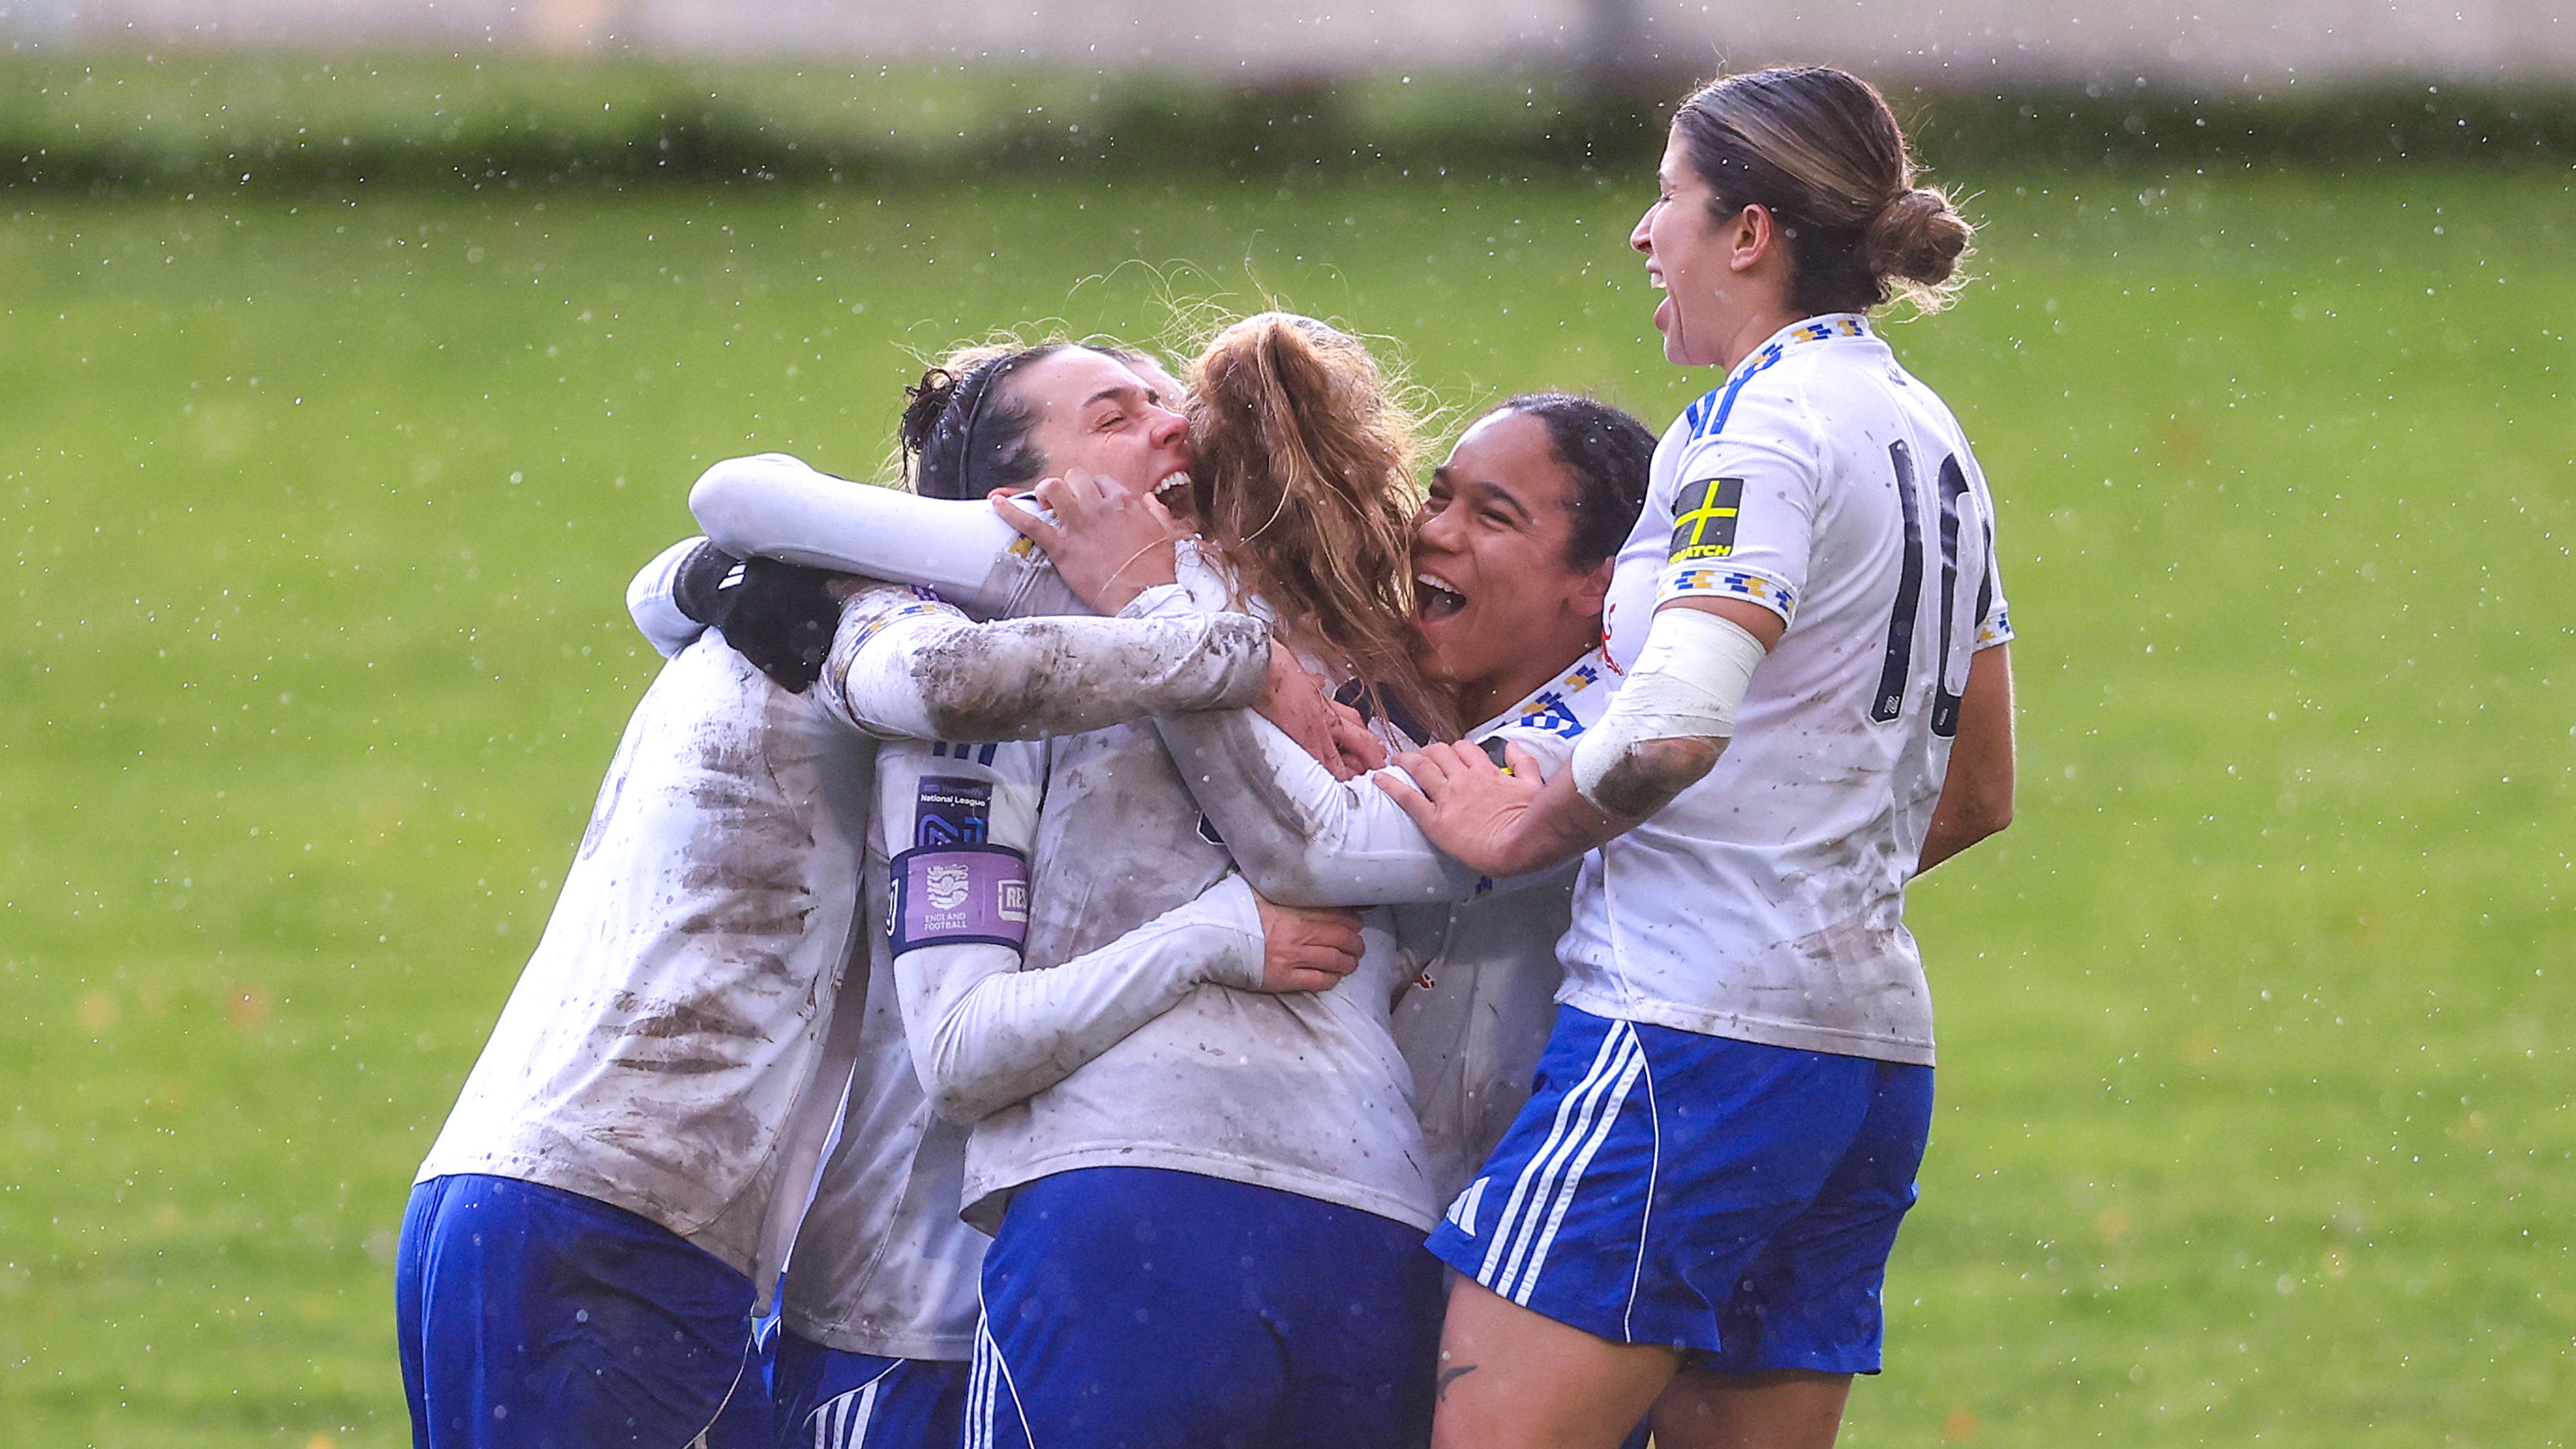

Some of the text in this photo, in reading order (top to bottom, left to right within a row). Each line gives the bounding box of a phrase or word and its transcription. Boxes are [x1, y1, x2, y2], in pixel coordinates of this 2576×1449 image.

[1869, 438, 1992, 739] 10
[920, 794, 986, 807] National League
[925, 912, 966, 923] ENGLAND
[924, 921, 967, 932] FOOTBALL
